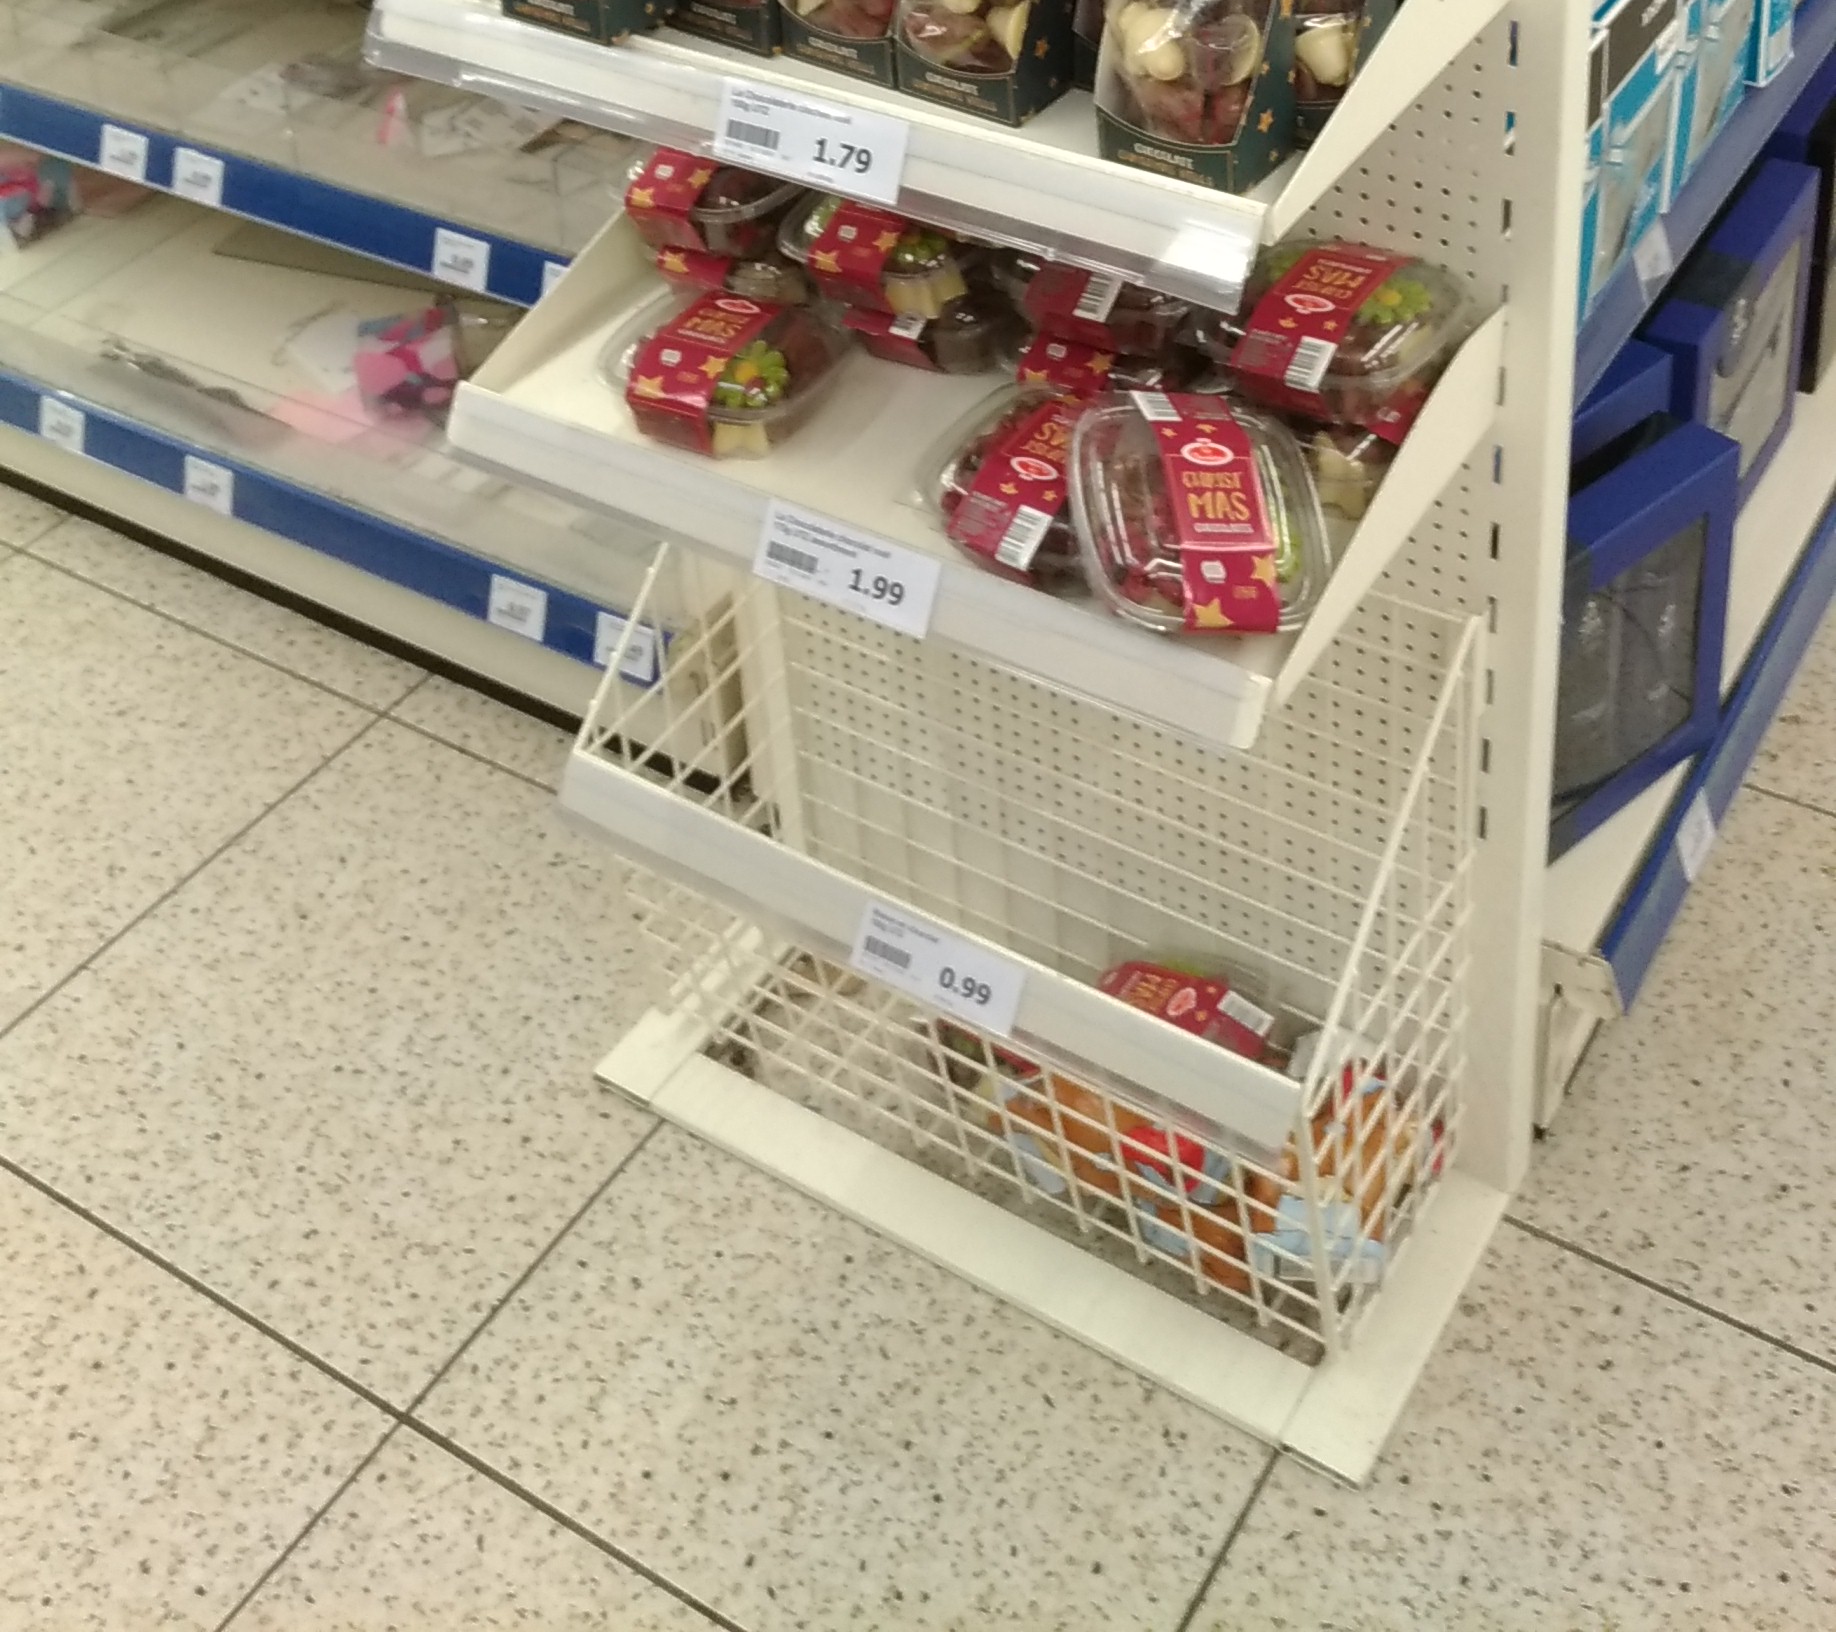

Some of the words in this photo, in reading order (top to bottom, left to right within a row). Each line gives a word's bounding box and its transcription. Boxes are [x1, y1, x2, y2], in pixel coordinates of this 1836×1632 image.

[812, 137, 873, 174] 1.79
[1186, 490, 1251, 521] MAS
[848, 567, 906, 606] 1.99
[938, 966, 993, 1006] 0.99
